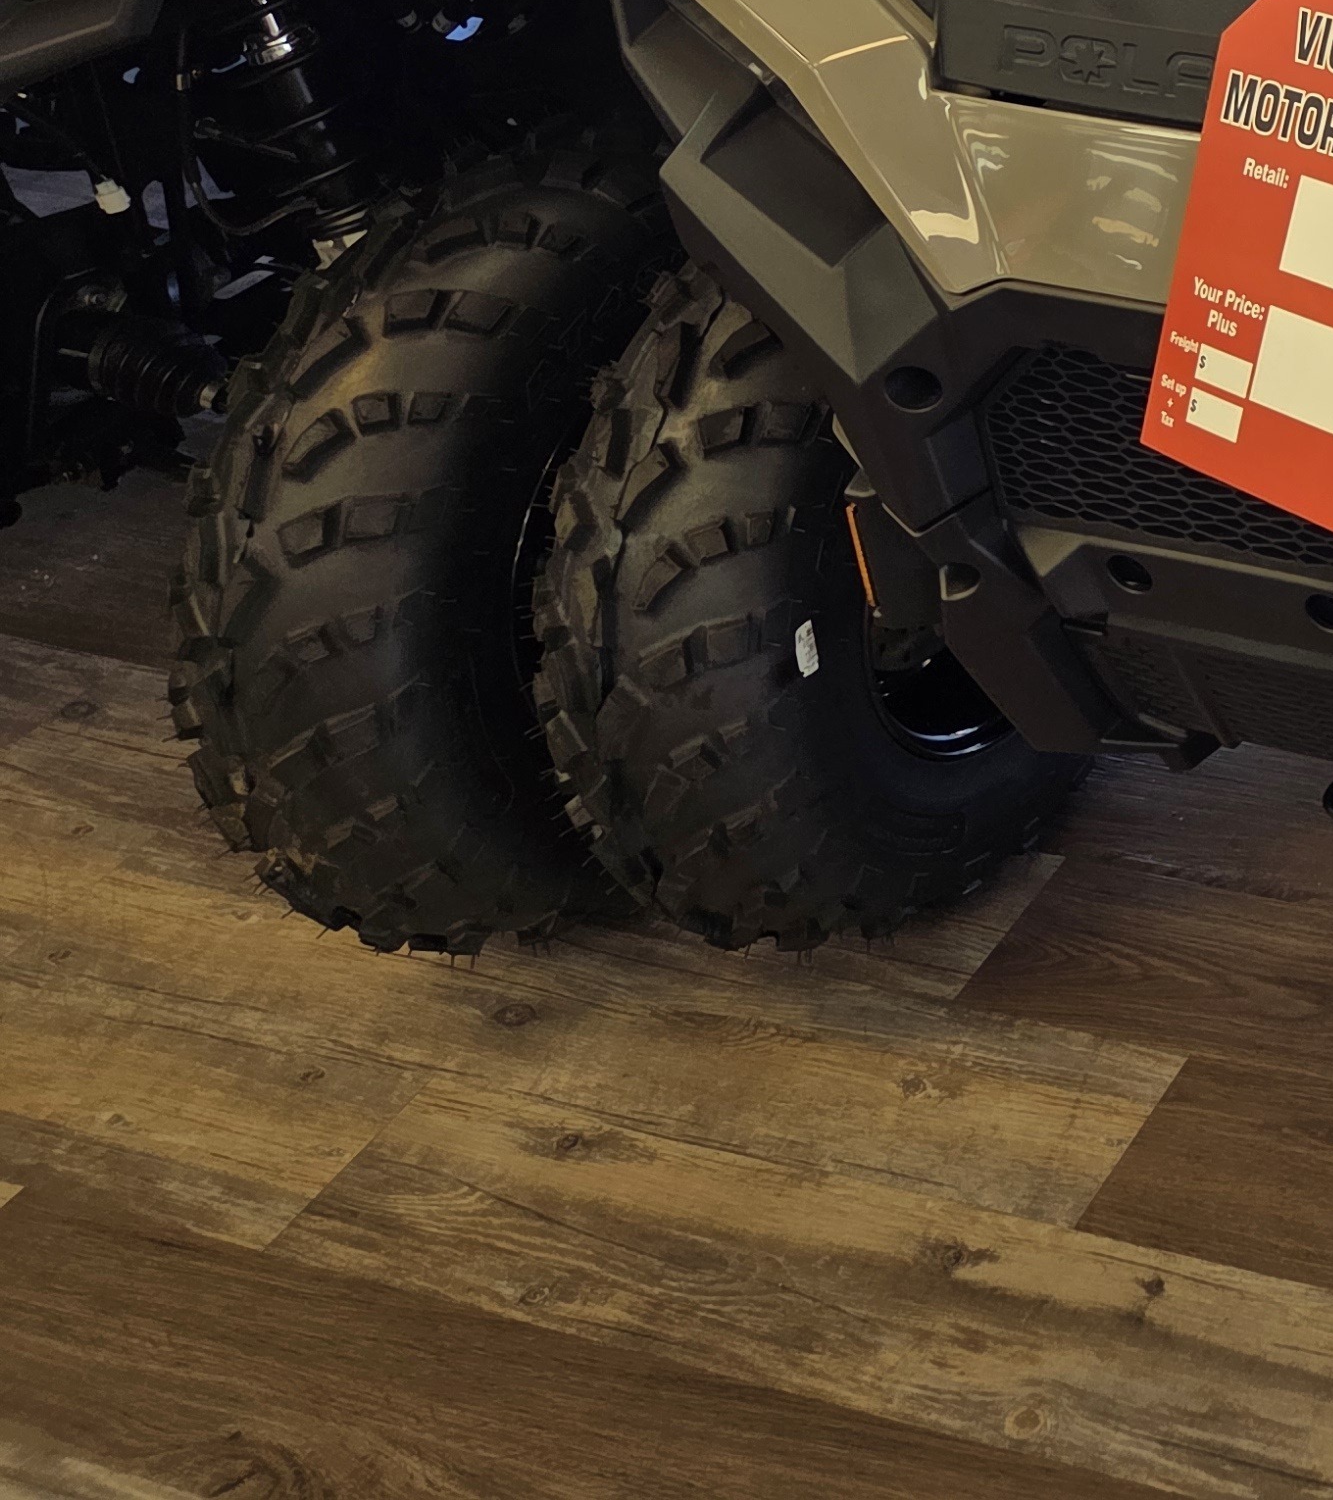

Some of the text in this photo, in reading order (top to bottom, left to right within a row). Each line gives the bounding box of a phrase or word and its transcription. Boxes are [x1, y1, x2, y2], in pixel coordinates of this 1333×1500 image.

[1000, 23, 1217, 98] POLA
[1242, 157, 1291, 189] Retail:
[1193, 275, 1266, 321] Your Price:
[1206, 308, 1239, 338] Plus
[1169, 330, 1200, 355] Freight
[1198, 354, 1207, 370] $
[1160, 373, 1188, 398] Set up
[1189, 398, 1198, 413] $
[1160, 410, 1175, 429] Tax
